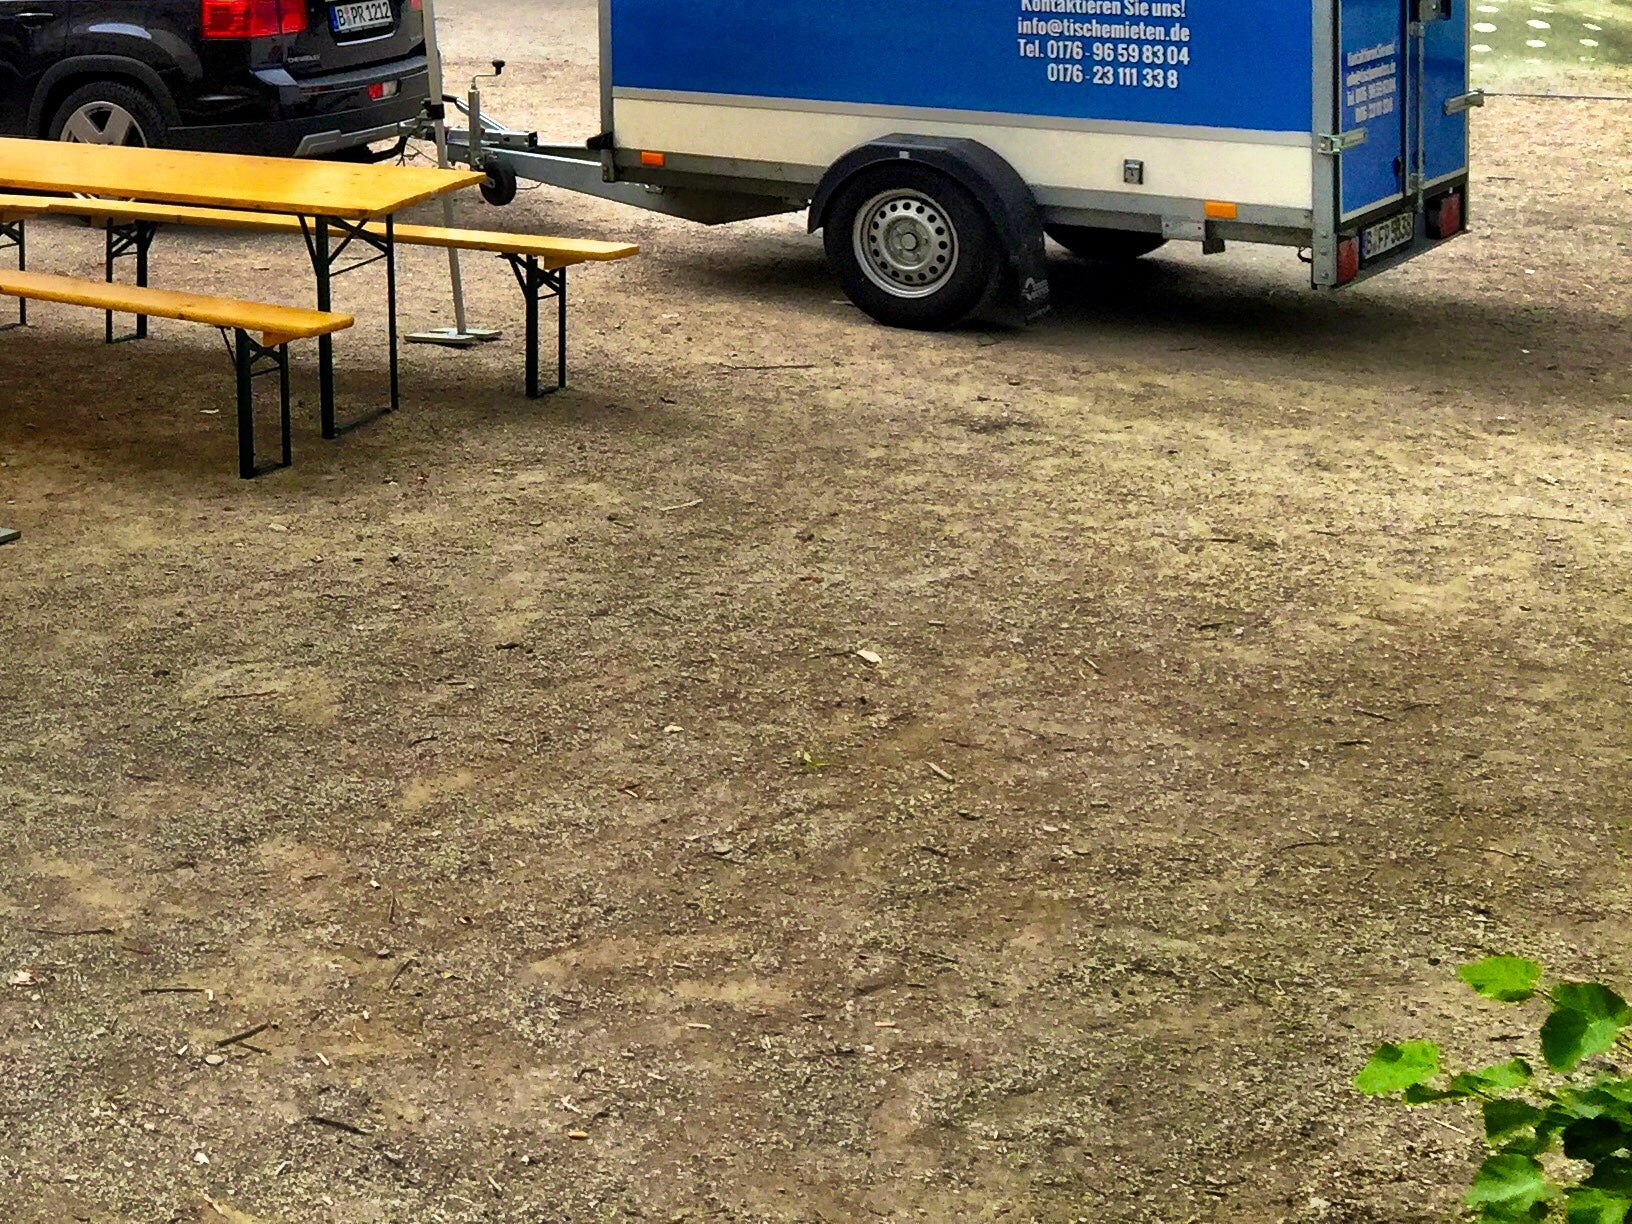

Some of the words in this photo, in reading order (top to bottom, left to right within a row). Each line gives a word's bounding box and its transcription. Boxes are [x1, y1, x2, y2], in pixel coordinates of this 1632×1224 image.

[1151, 0, 1187, 18] uns!
[1018, 17, 1190, 42] info@tischemieten.de
[1017, 38, 1045, 58] Tel.
